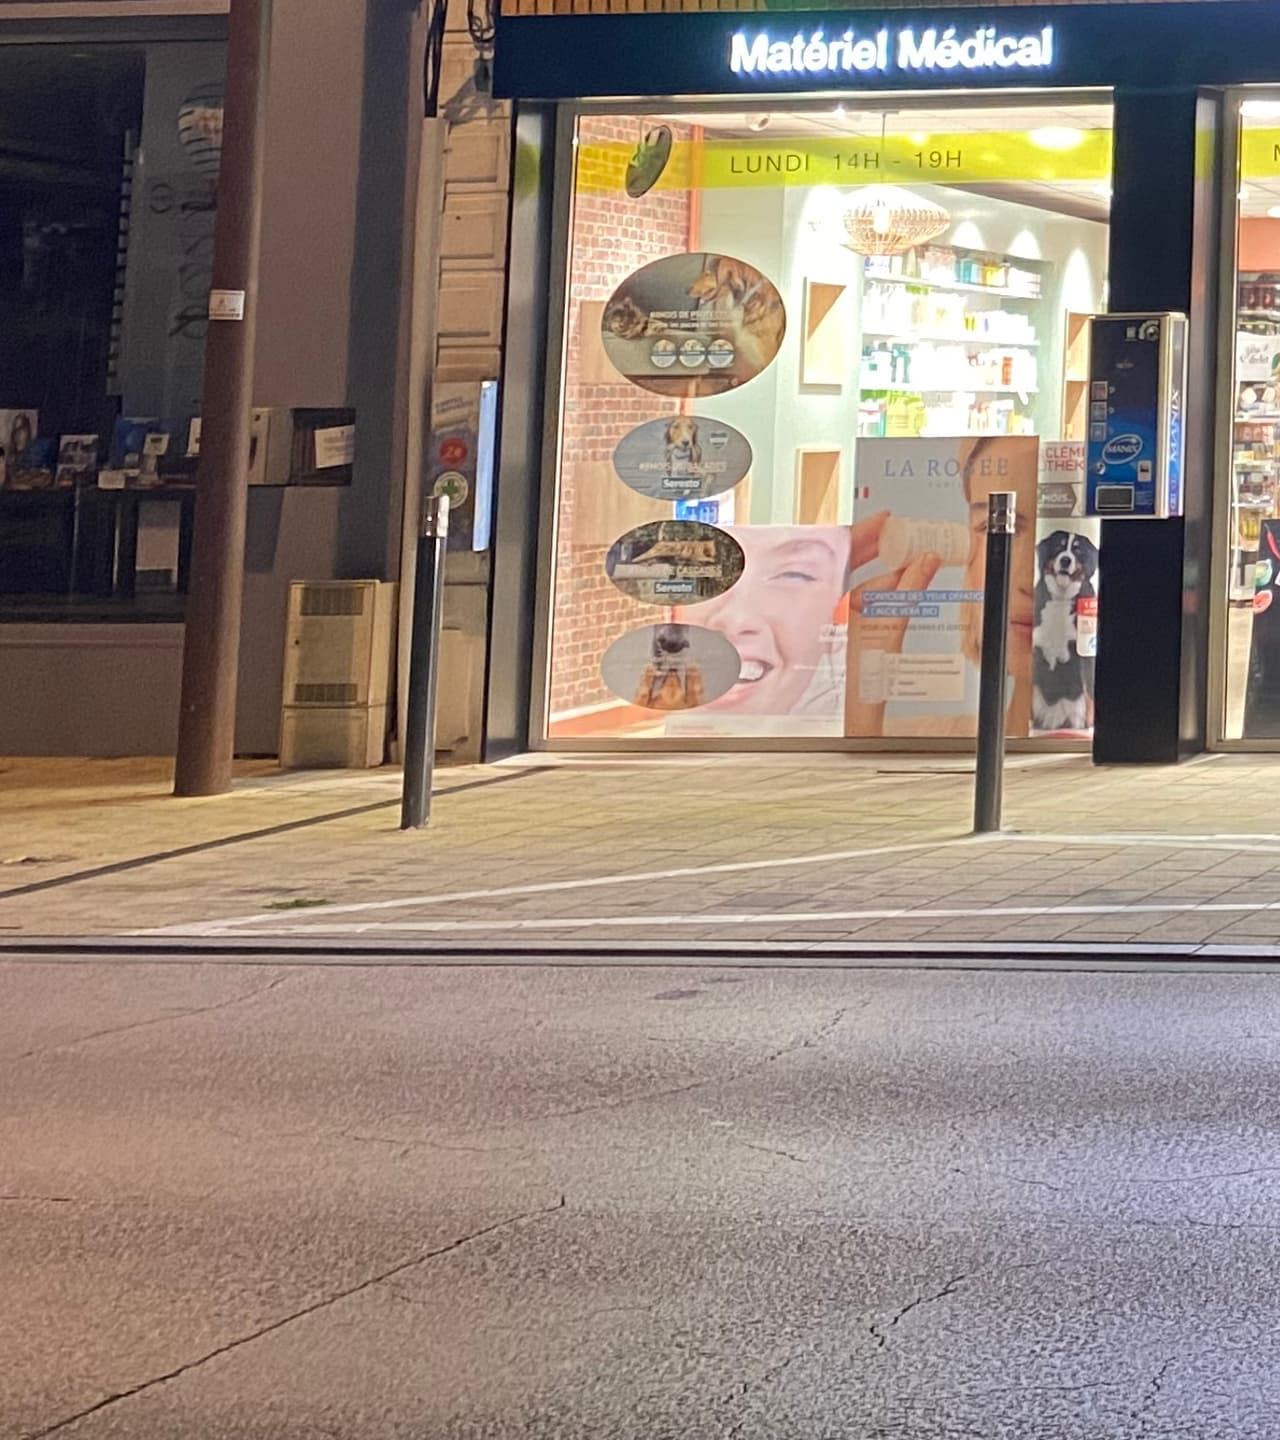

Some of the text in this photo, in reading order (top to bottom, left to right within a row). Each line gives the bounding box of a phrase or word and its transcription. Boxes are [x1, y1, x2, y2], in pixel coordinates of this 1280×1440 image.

[730, 26, 1053, 72] Matériel Médical
[730, 153, 810, 174] LUNDI
[833, 152, 880, 170] 14H
[914, 150, 962, 168] 19H
[1170, 390, 1180, 463] MANIX
[1107, 444, 1138, 455] MANIX
[884, 456, 1010, 477] LA ROÉE
